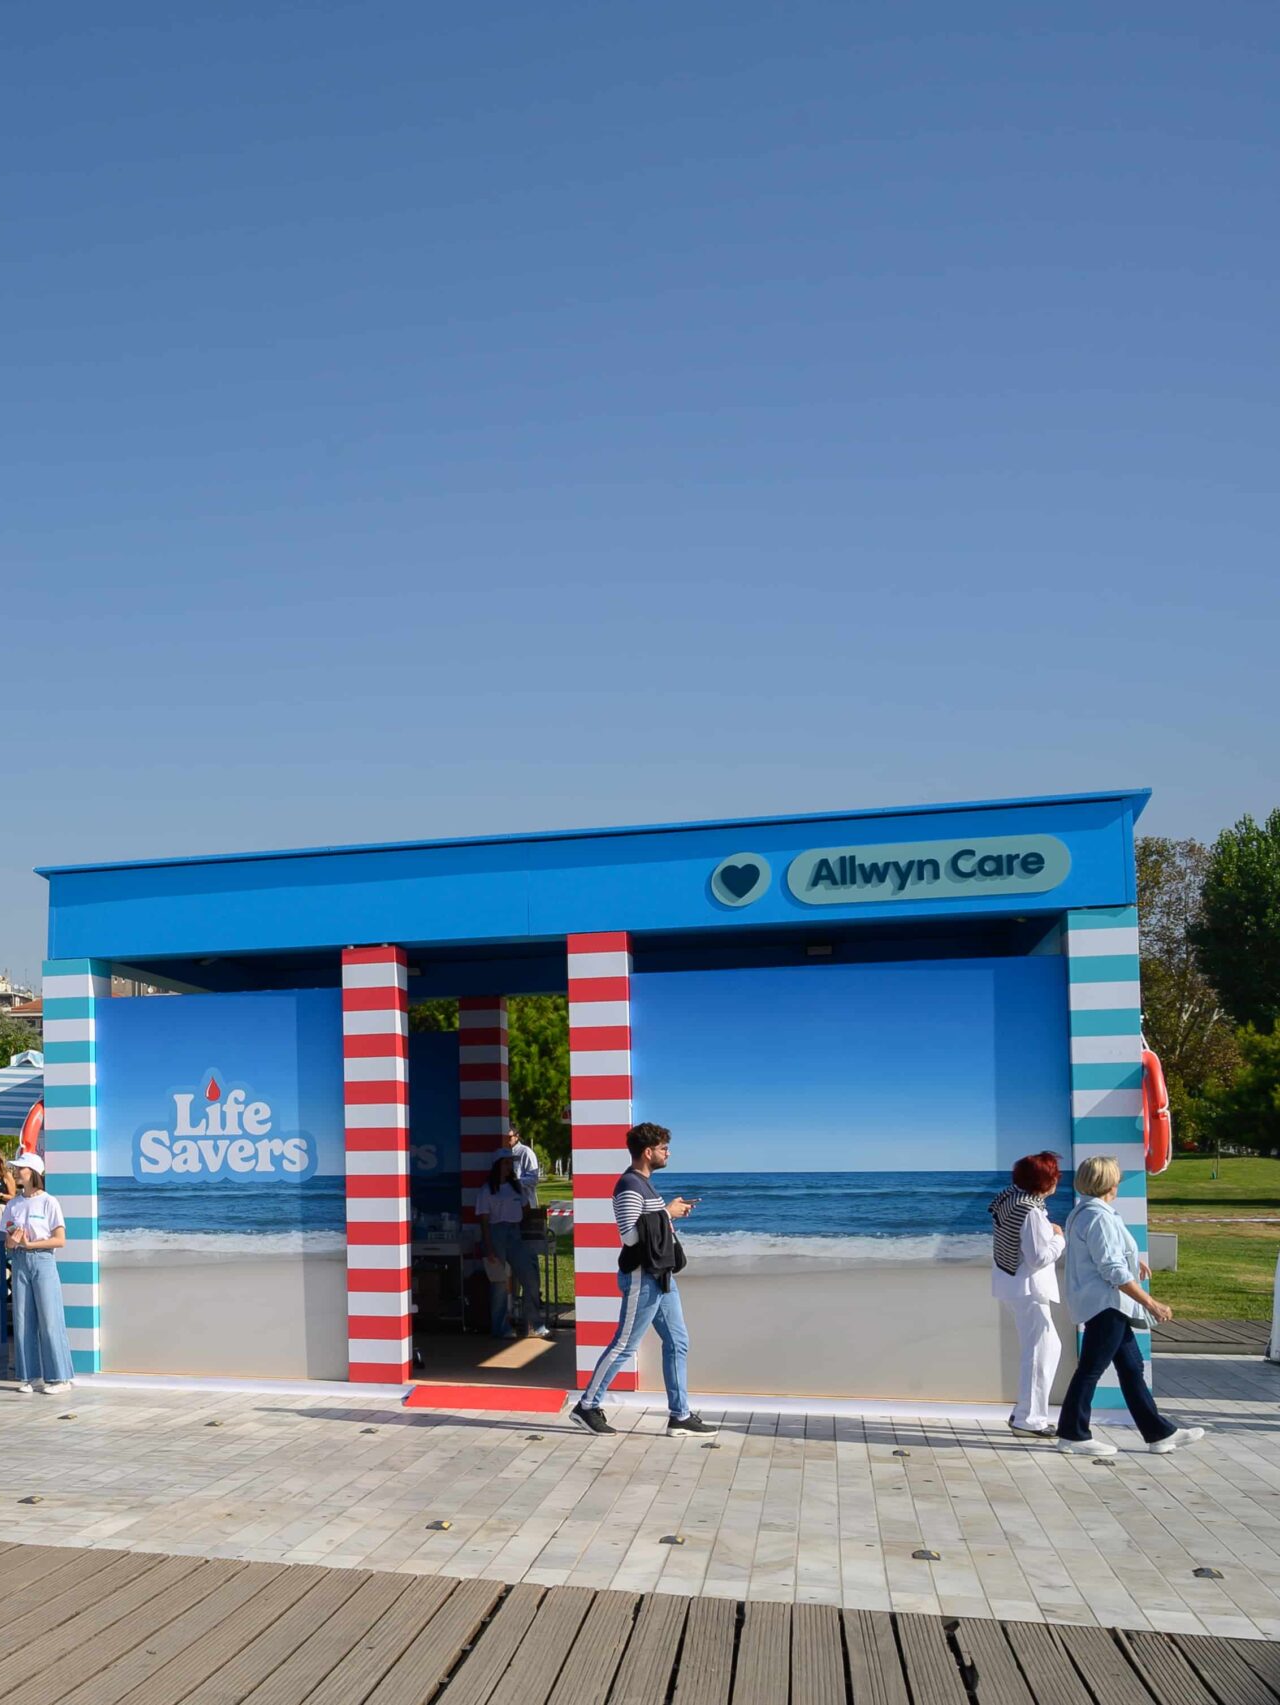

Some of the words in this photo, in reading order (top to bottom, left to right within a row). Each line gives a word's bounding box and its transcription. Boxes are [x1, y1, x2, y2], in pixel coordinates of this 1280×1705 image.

[811, 854, 941, 891] Allwyn
[951, 848, 1046, 879] Care
[173, 1078, 272, 1136] Life
[139, 1130, 310, 1174] Savers
